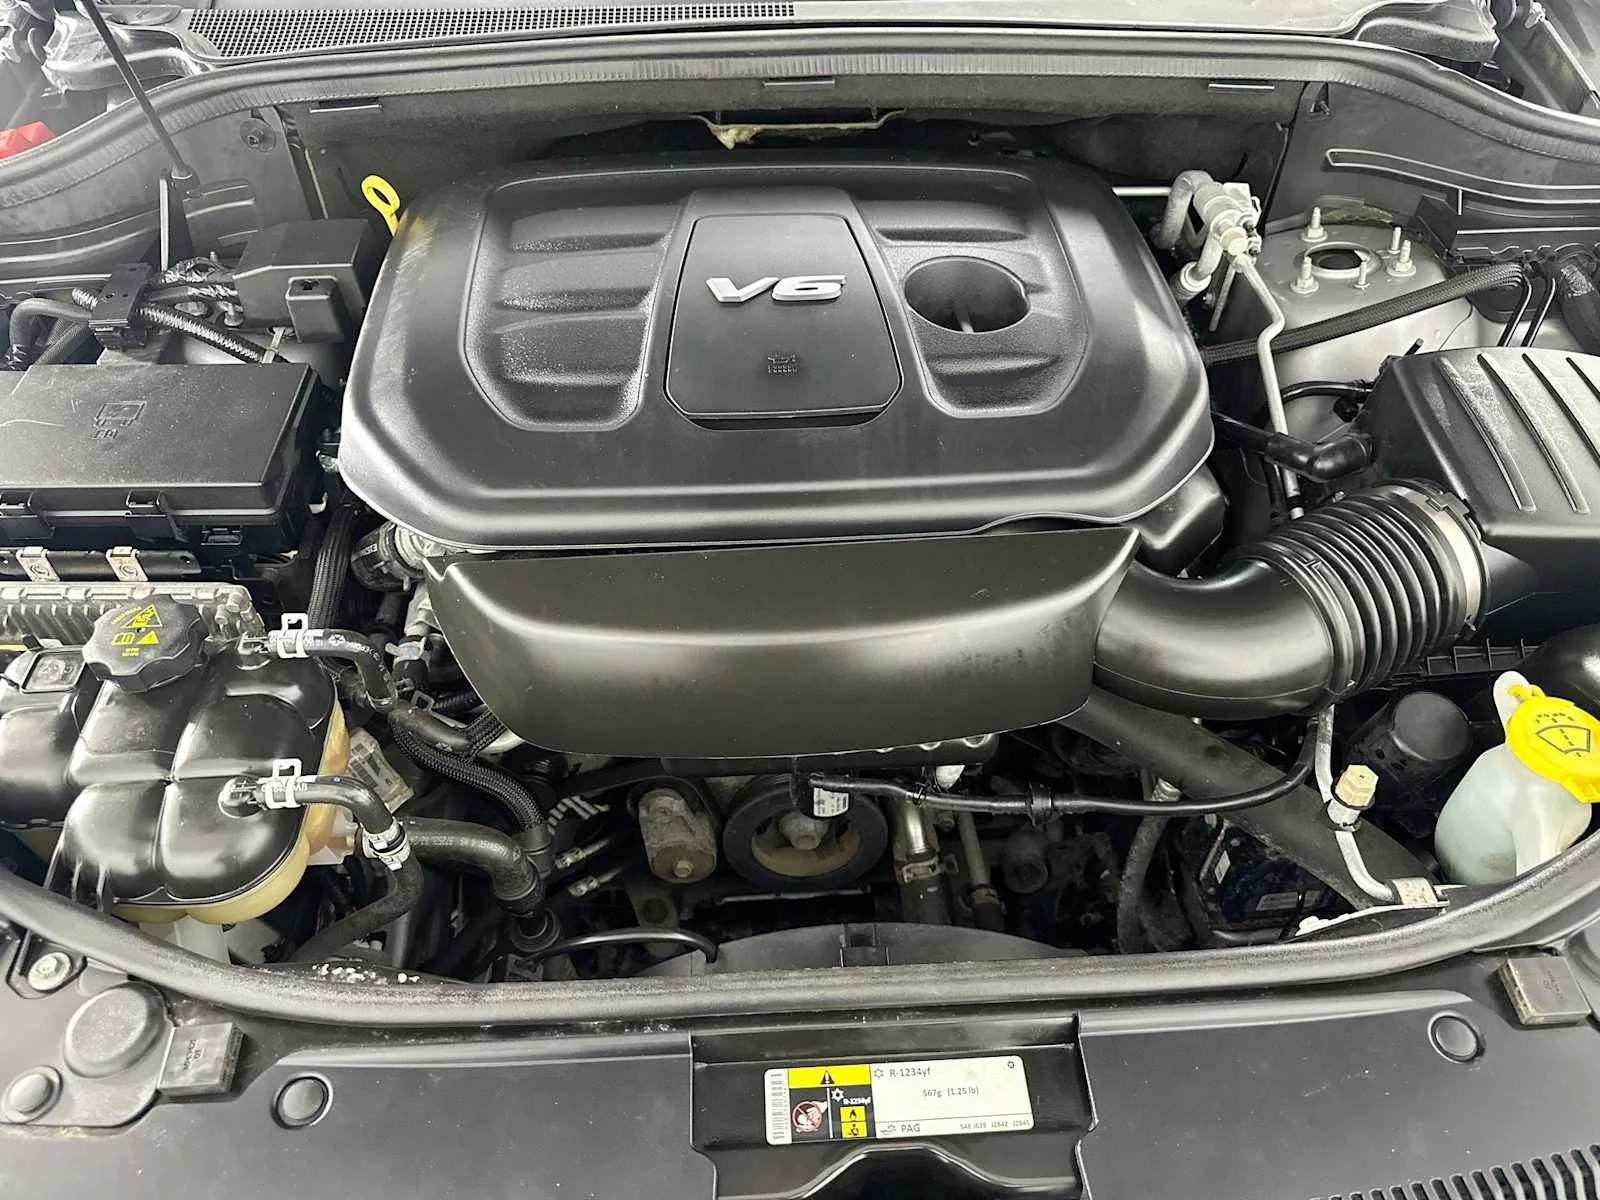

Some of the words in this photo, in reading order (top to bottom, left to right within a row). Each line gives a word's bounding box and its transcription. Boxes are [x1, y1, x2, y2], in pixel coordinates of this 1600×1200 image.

[706, 275, 846, 302] V6
[889, 1066, 930, 1078] R-1234yf
[922, 1089, 942, 1098] 567g
[947, 1087, 967, 1097] (1.25
[901, 1124, 921, 1133] PAG
